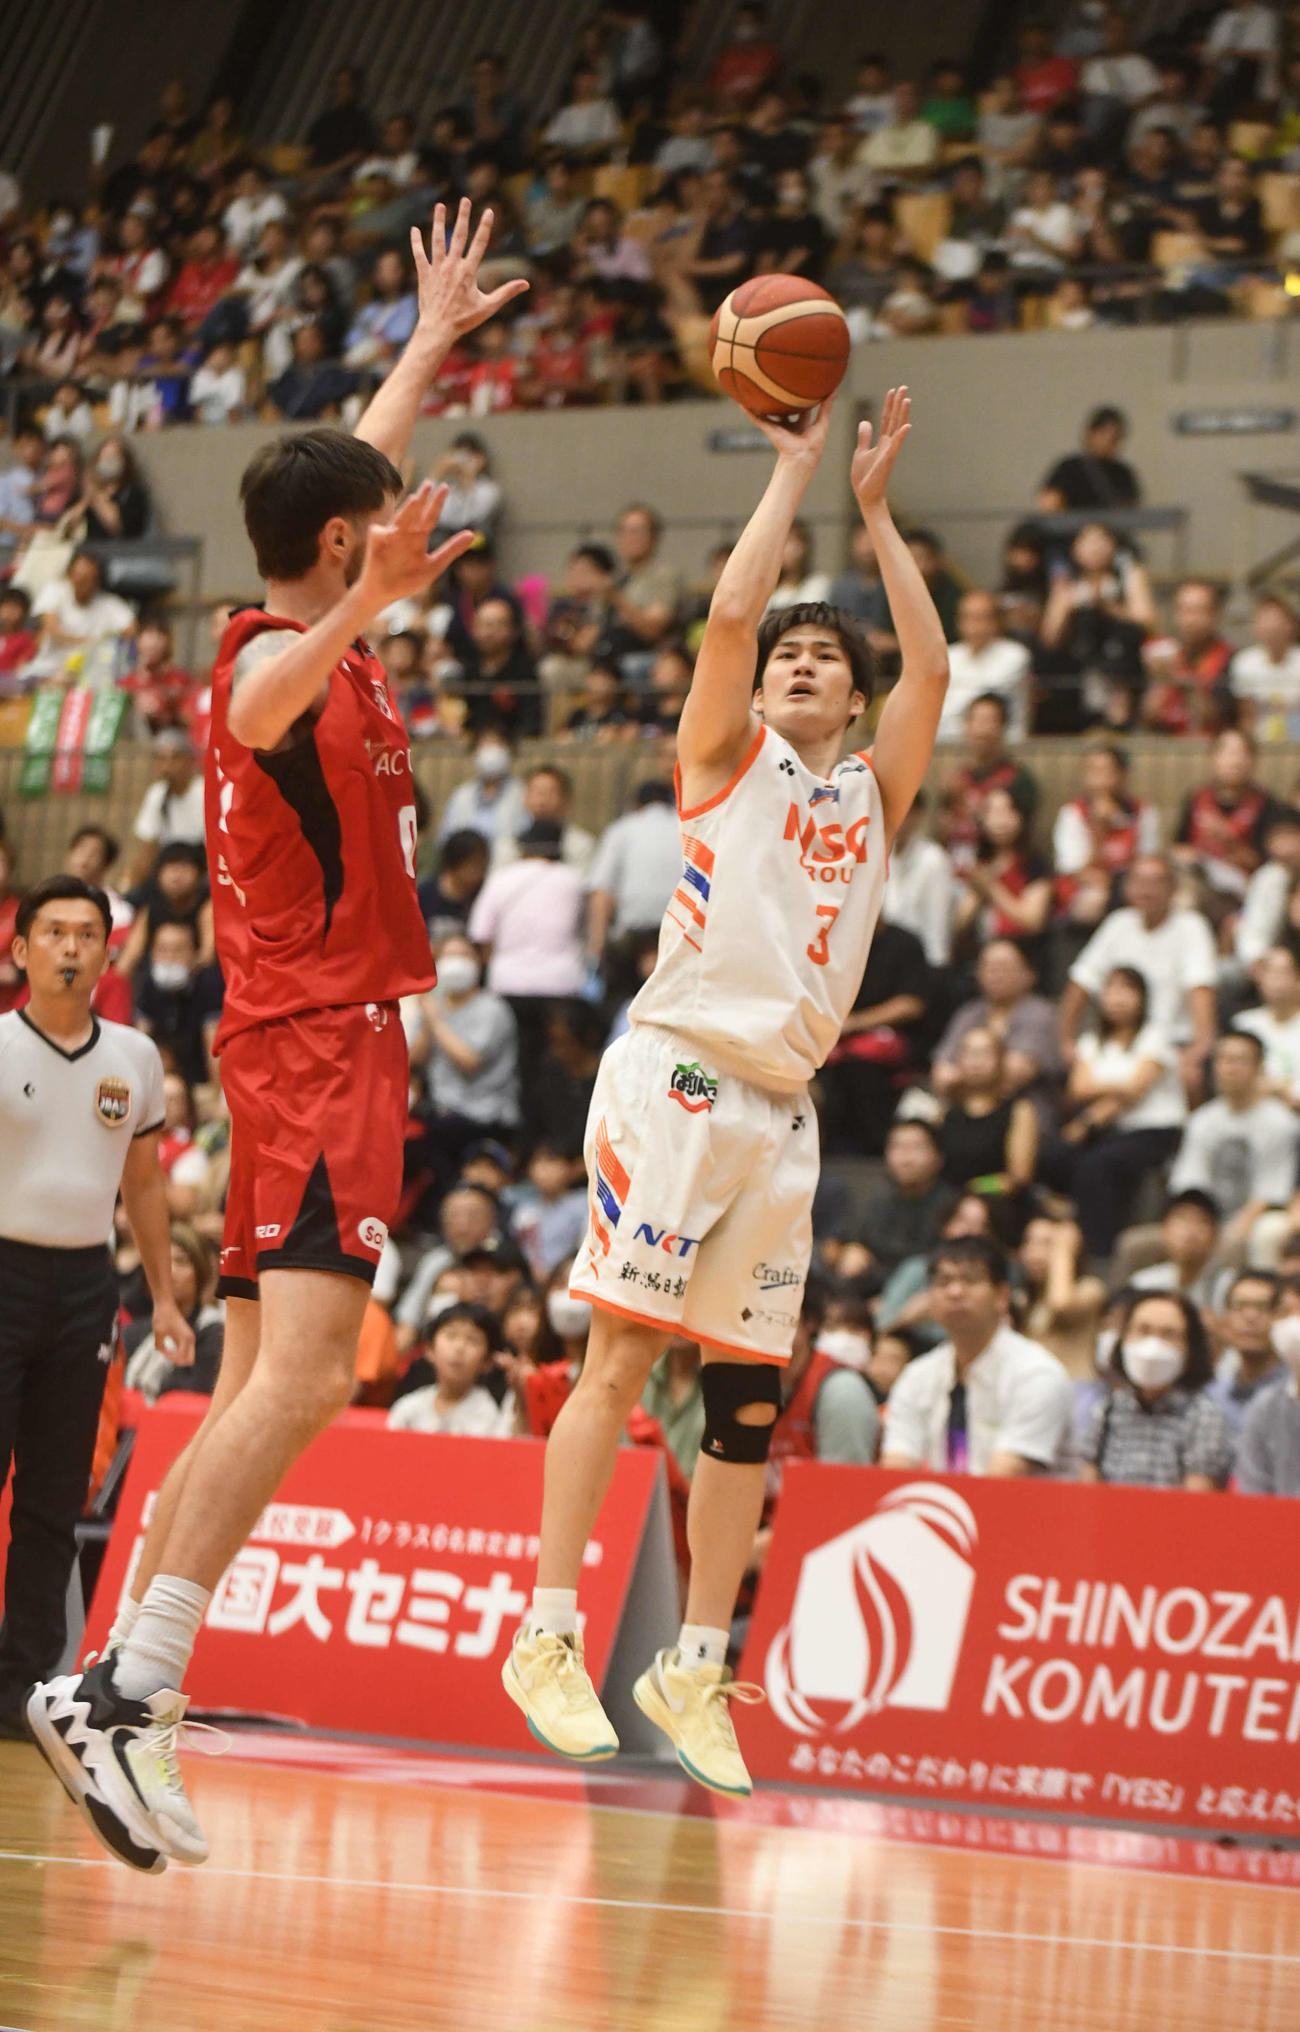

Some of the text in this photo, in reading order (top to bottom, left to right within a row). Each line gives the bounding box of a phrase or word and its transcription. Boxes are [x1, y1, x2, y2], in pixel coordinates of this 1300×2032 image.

[806, 904, 840, 966] 3
[205, 1546, 588, 1660] 国大セミナ
[998, 1574, 1300, 1663] SHINOZA
[982, 1654, 1300, 1744] KOMUTE
